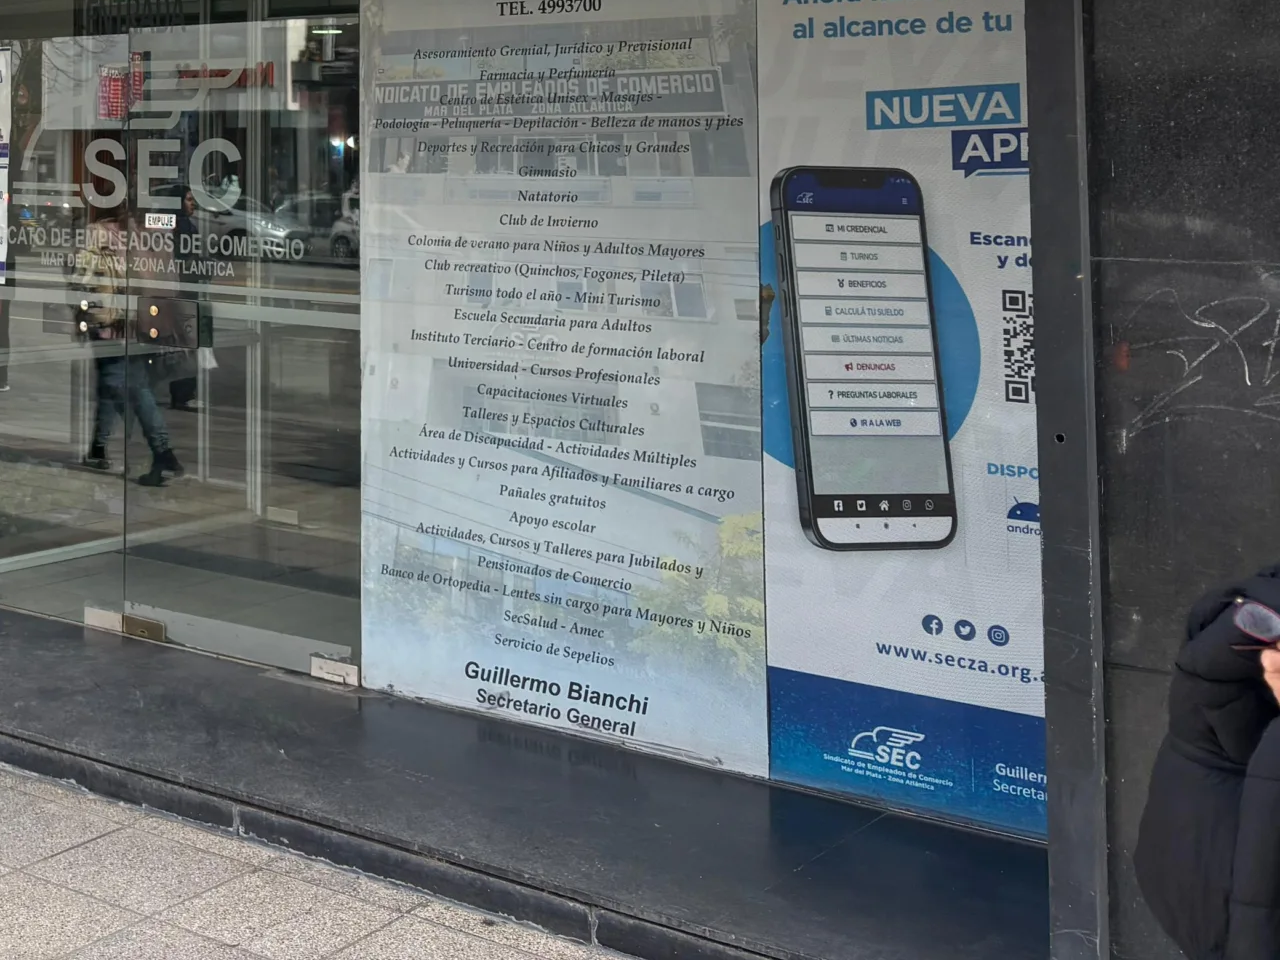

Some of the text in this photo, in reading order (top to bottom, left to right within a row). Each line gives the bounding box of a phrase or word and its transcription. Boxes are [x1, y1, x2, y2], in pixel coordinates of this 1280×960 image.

[497, 1, 533, 16] TEL.
[793, 11, 1012, 39] al alcance de tu
[414, 38, 692, 60] Asesoramiento Gremial, Jurídico y Previsional
[874, 92, 1015, 126] NUEVA
[83, 138, 242, 212] SEC
[518, 166, 577, 178] Gimnasio
[518, 190, 578, 203] Natatorio
[147, 215, 175, 227] EMPUJE
[499, 214, 598, 228] Club de Invierno
[52, 229, 71, 247] DE
[76, 229, 174, 252] EMPLEADOS
[180, 233, 201, 255] DE
[207, 236, 304, 260] COMERCIO
[41, 252, 64, 266] MAR
[68, 254, 88, 268] DEL
[91, 256, 126, 269] PLATA
[169, 260, 235, 278] ATLANTICA
[848, 280, 886, 288] BENEFICIOS
[477, 383, 628, 409] Capacitaciones Virtuales
[499, 484, 606, 510] Pañales gratuitos
[509, 511, 596, 534] Apoyo escolar
[495, 633, 615, 667] Servicio de Sepelios
[465, 660, 649, 715] Guillermo Bianchi
[476, 688, 635, 737] Secretario General
[824, 753, 854, 766] Sindicato
[867, 763, 906, 776] Empleados
[919, 774, 953, 787] Comercio
[875, 745, 921, 769] SEC
